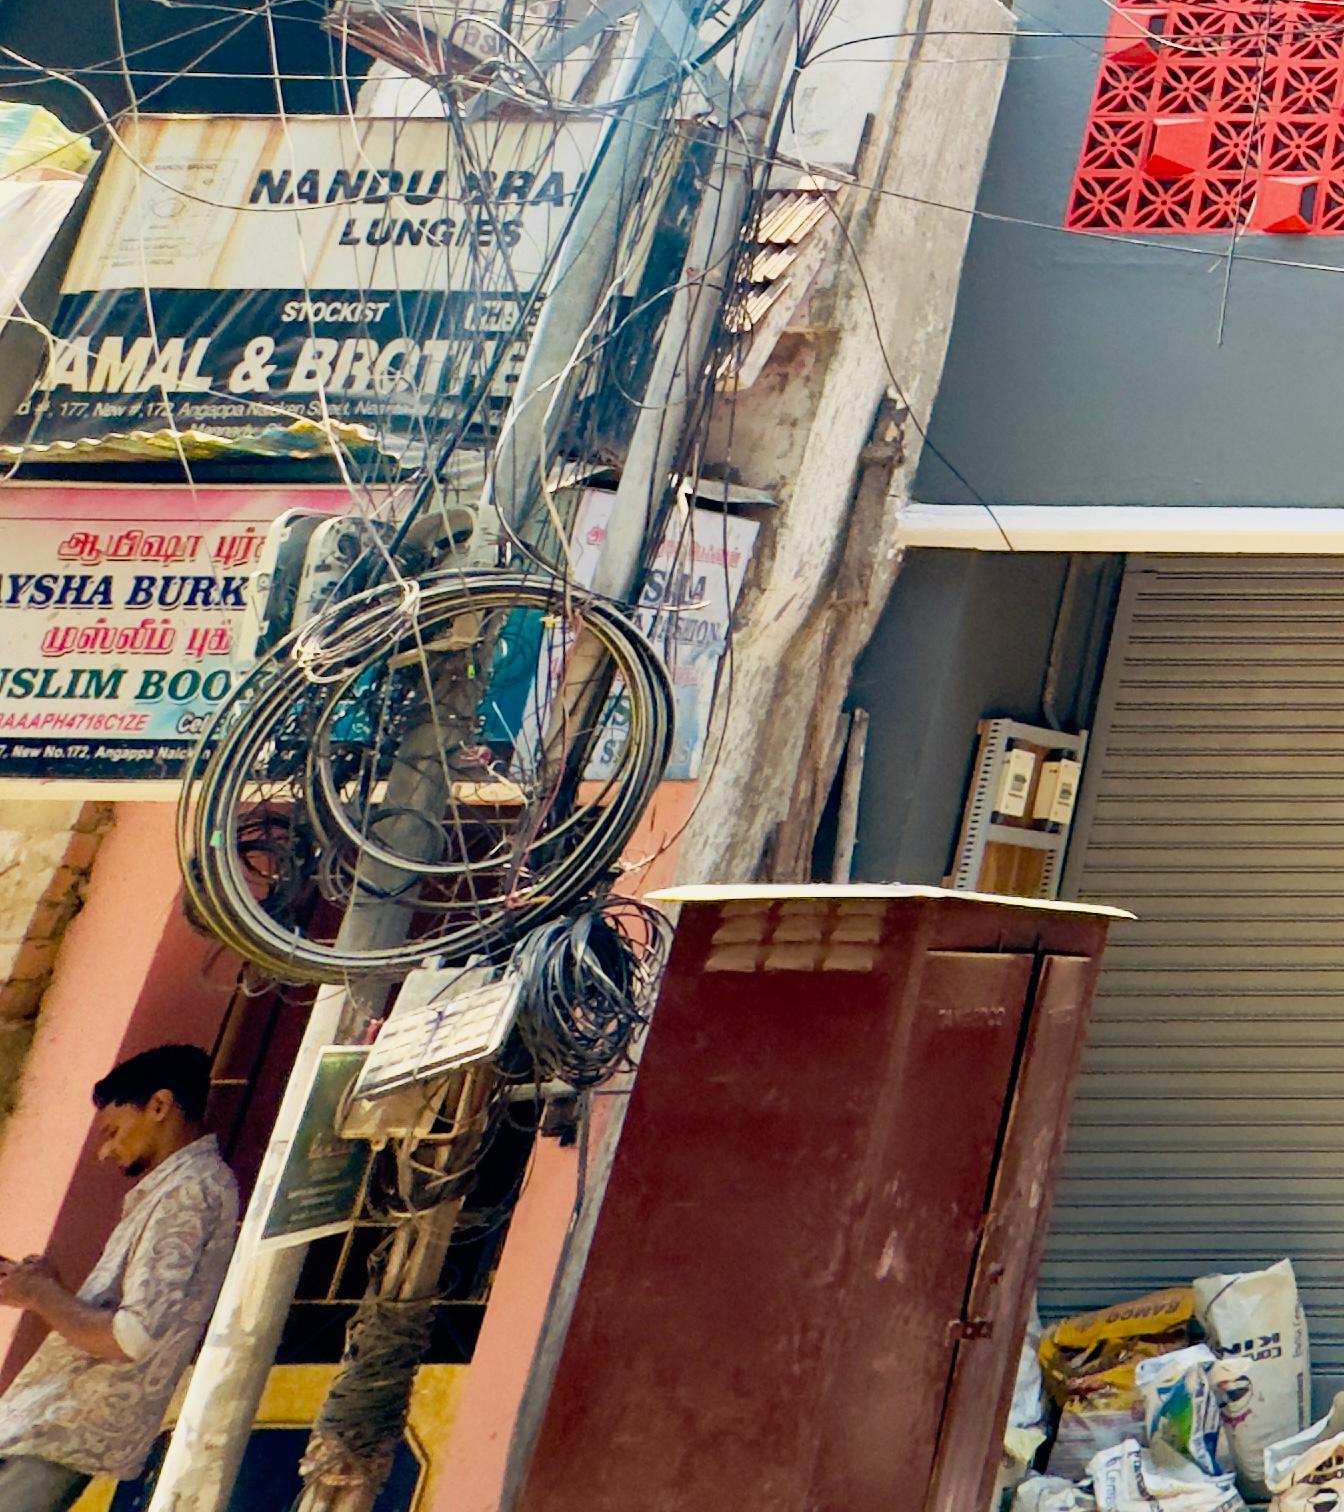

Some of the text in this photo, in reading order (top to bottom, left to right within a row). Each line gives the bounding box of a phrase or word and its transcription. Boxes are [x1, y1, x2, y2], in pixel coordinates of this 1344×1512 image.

[248, 168, 447, 207] NANDU
[338, 218, 524, 248] LUNGIES
[280, 300, 391, 323] STOCKIST
[228, 336, 278, 393] &
[0, 573, 250, 607] YSHA BURK
